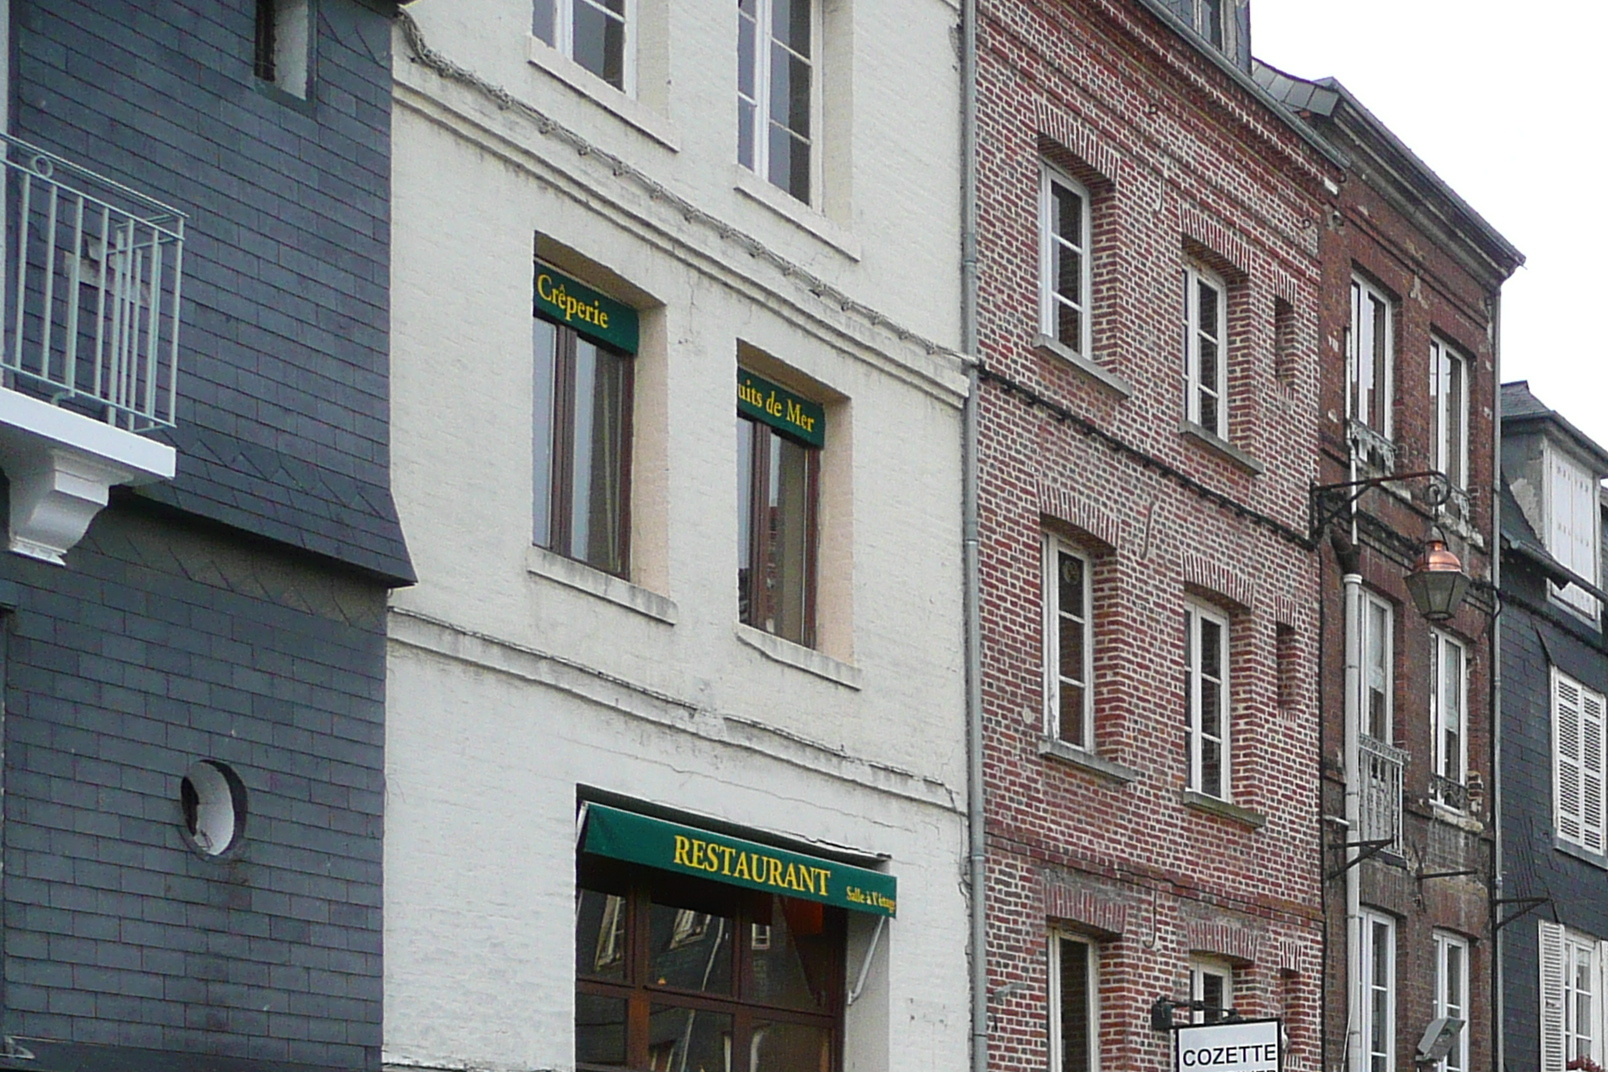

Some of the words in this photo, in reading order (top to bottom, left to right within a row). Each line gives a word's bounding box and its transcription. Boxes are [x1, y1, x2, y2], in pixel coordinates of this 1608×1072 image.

[537, 273, 609, 329] Crêperie
[766, 391, 783, 418] de
[786, 398, 815, 433] Mer
[673, 834, 831, 896] RESTAURANT
[1182, 1043, 1277, 1067] COZETTE
